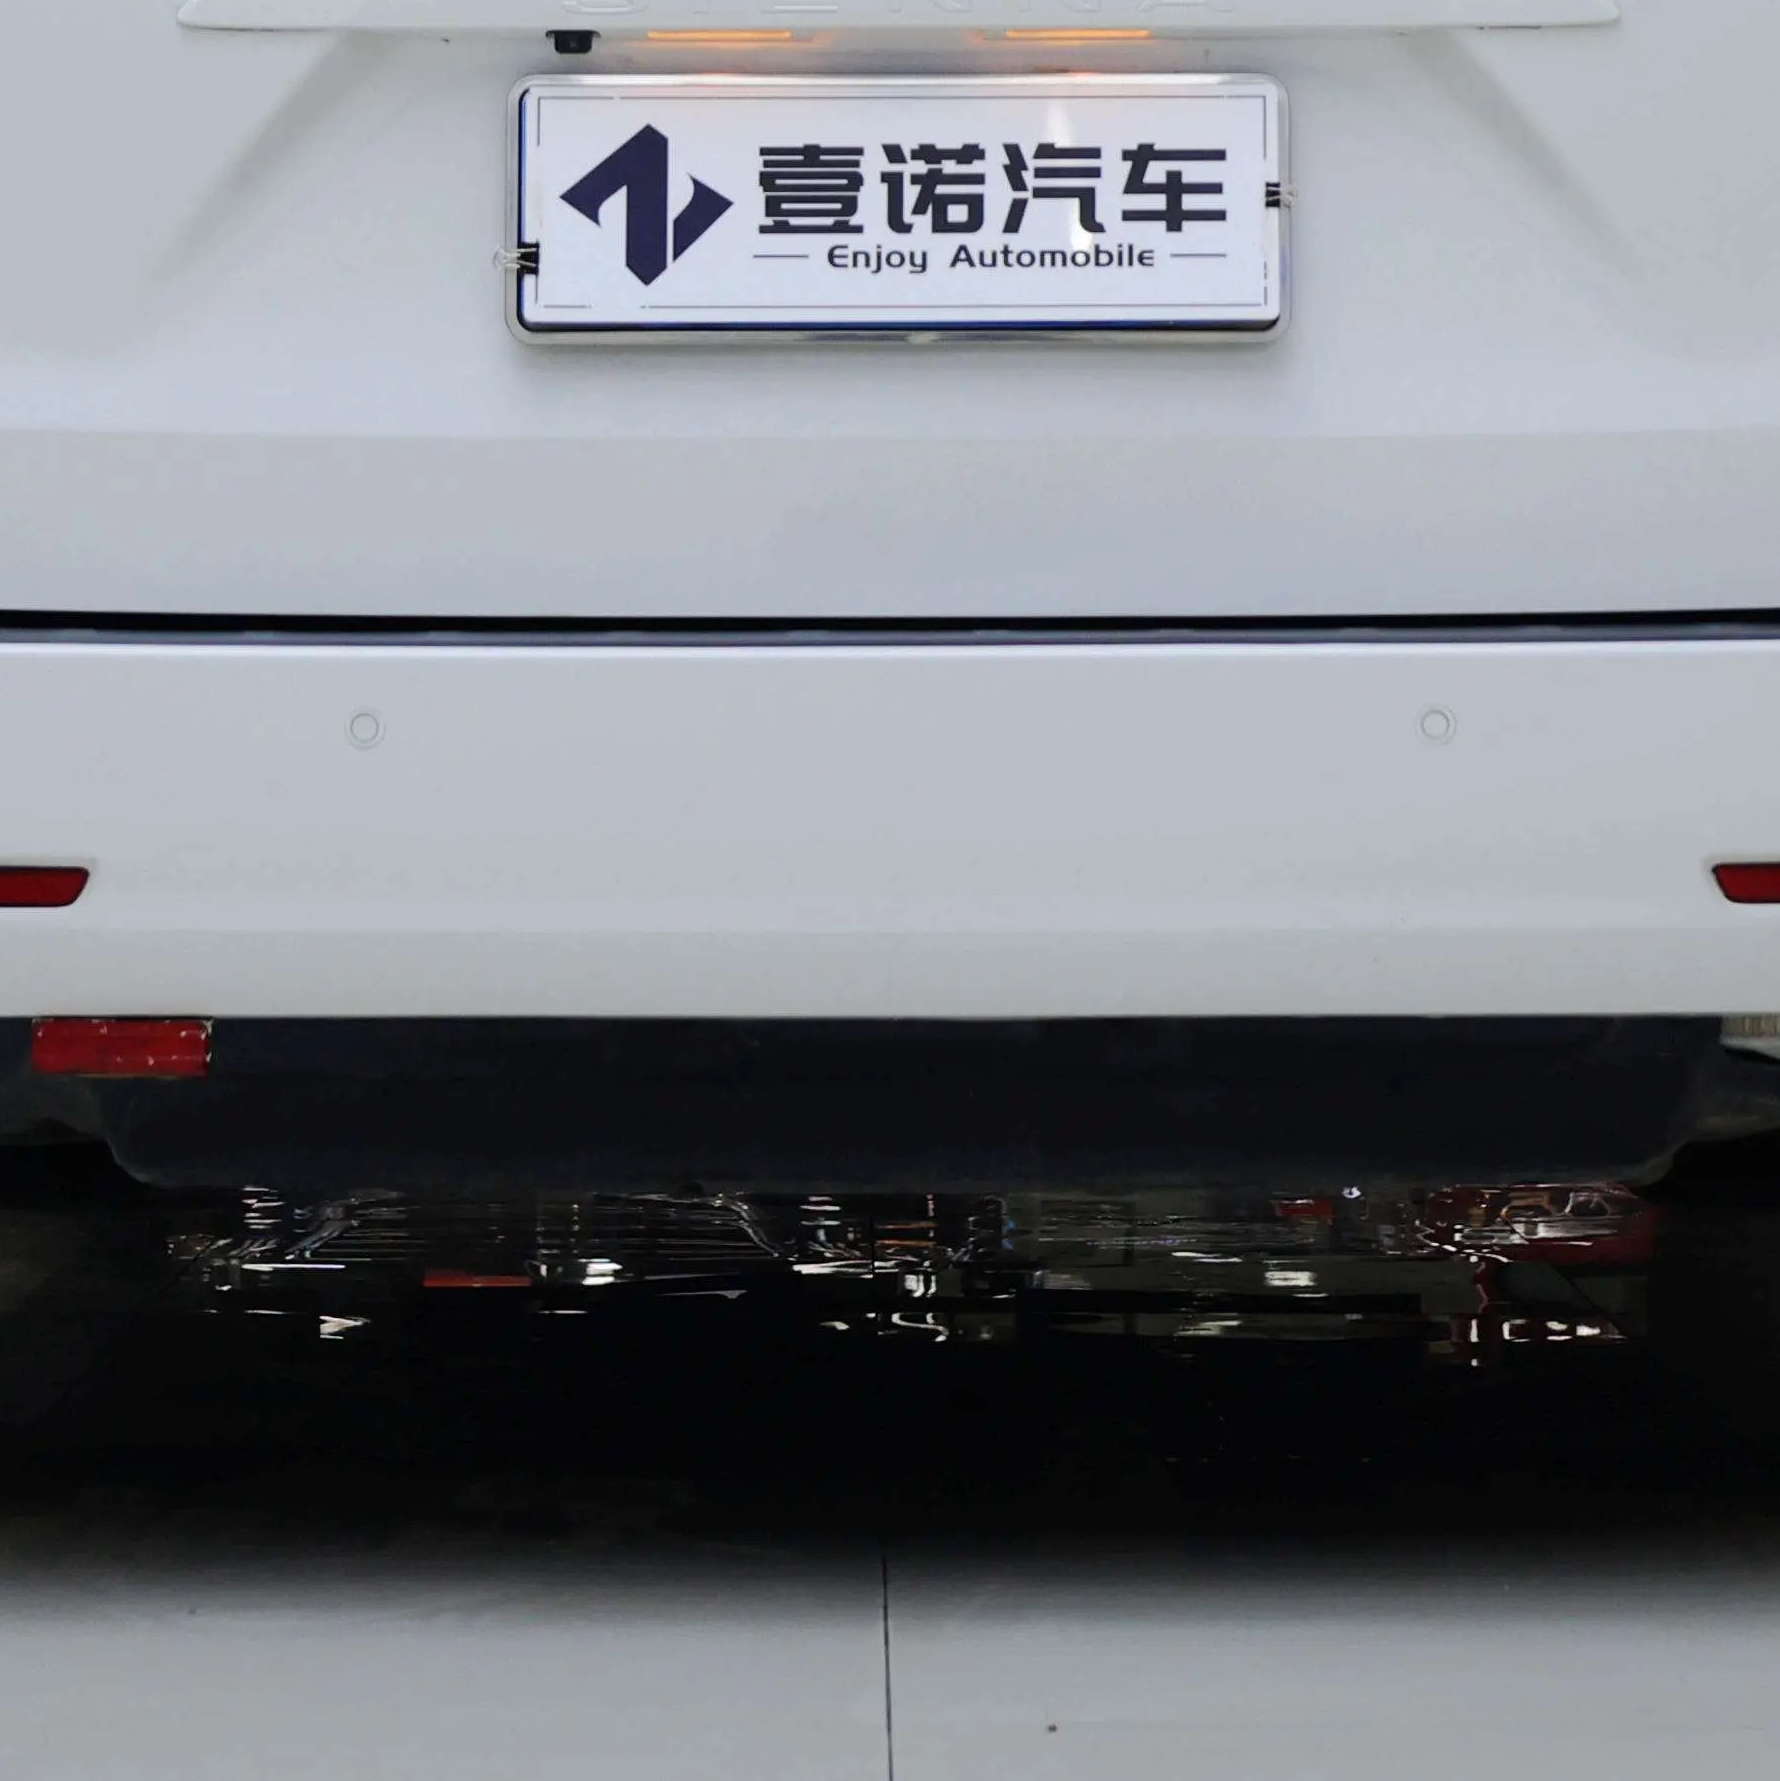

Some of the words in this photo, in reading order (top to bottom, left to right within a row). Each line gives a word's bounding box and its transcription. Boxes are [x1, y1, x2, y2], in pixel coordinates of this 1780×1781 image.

[758, 143, 1227, 235] 壹诺汽车
[826, 244, 928, 274] Enjoy
[950, 244, 1156, 269] Automobile
